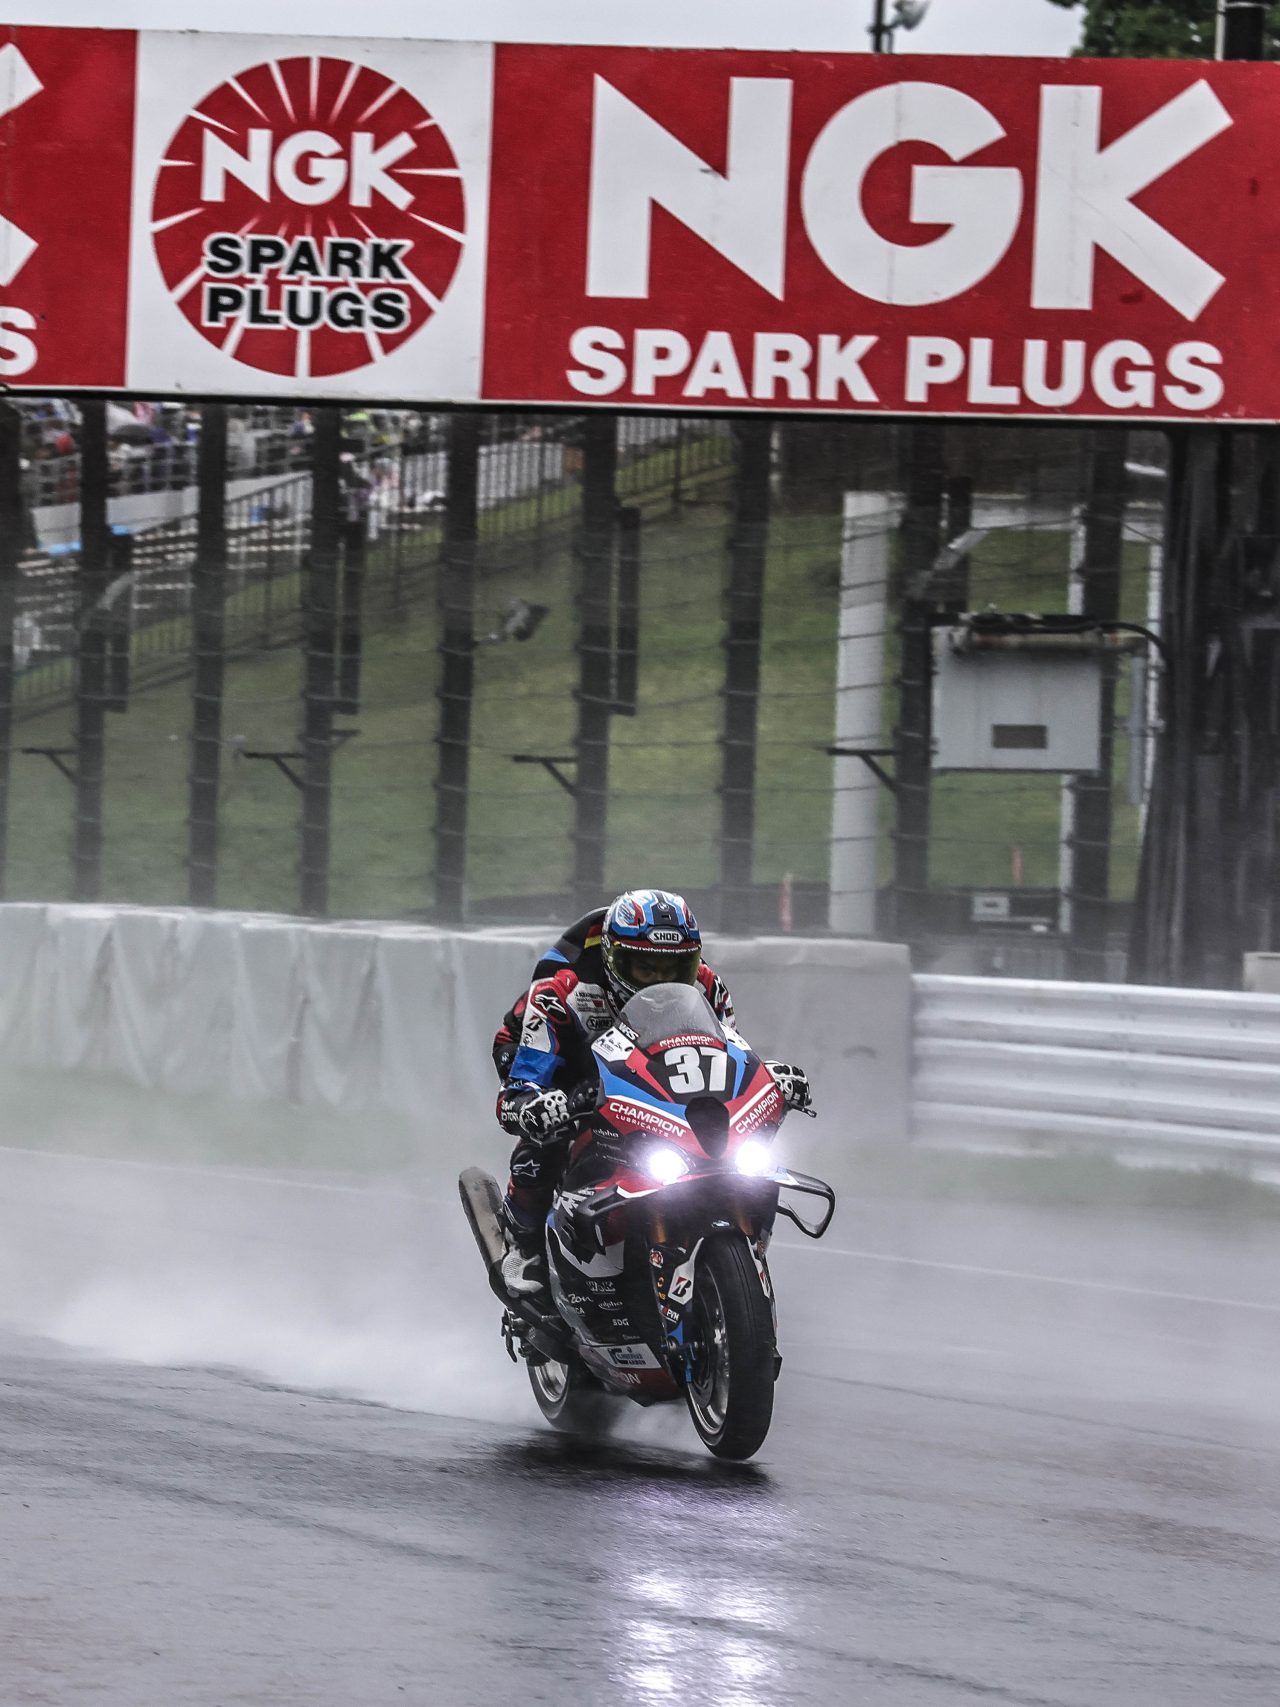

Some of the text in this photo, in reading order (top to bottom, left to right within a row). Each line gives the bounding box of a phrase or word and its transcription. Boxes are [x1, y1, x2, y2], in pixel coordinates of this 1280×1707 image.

[201, 129, 417, 210] NGK
[586, 74, 1233, 321] NGK
[206, 237, 406, 279] SPARK
[207, 287, 406, 329] PLUGS
[567, 326, 1223, 410] SPARK PLUGS
[653, 932, 680, 941] SHOEI
[664, 1046, 728, 1094] 37
[609, 1102, 686, 1138] CHAMPION
[615, 1114, 669, 1138] LUBRICANTS
[735, 1089, 779, 1134] CHAMPION
[747, 1103, 778, 1133] LUBRICANTS
